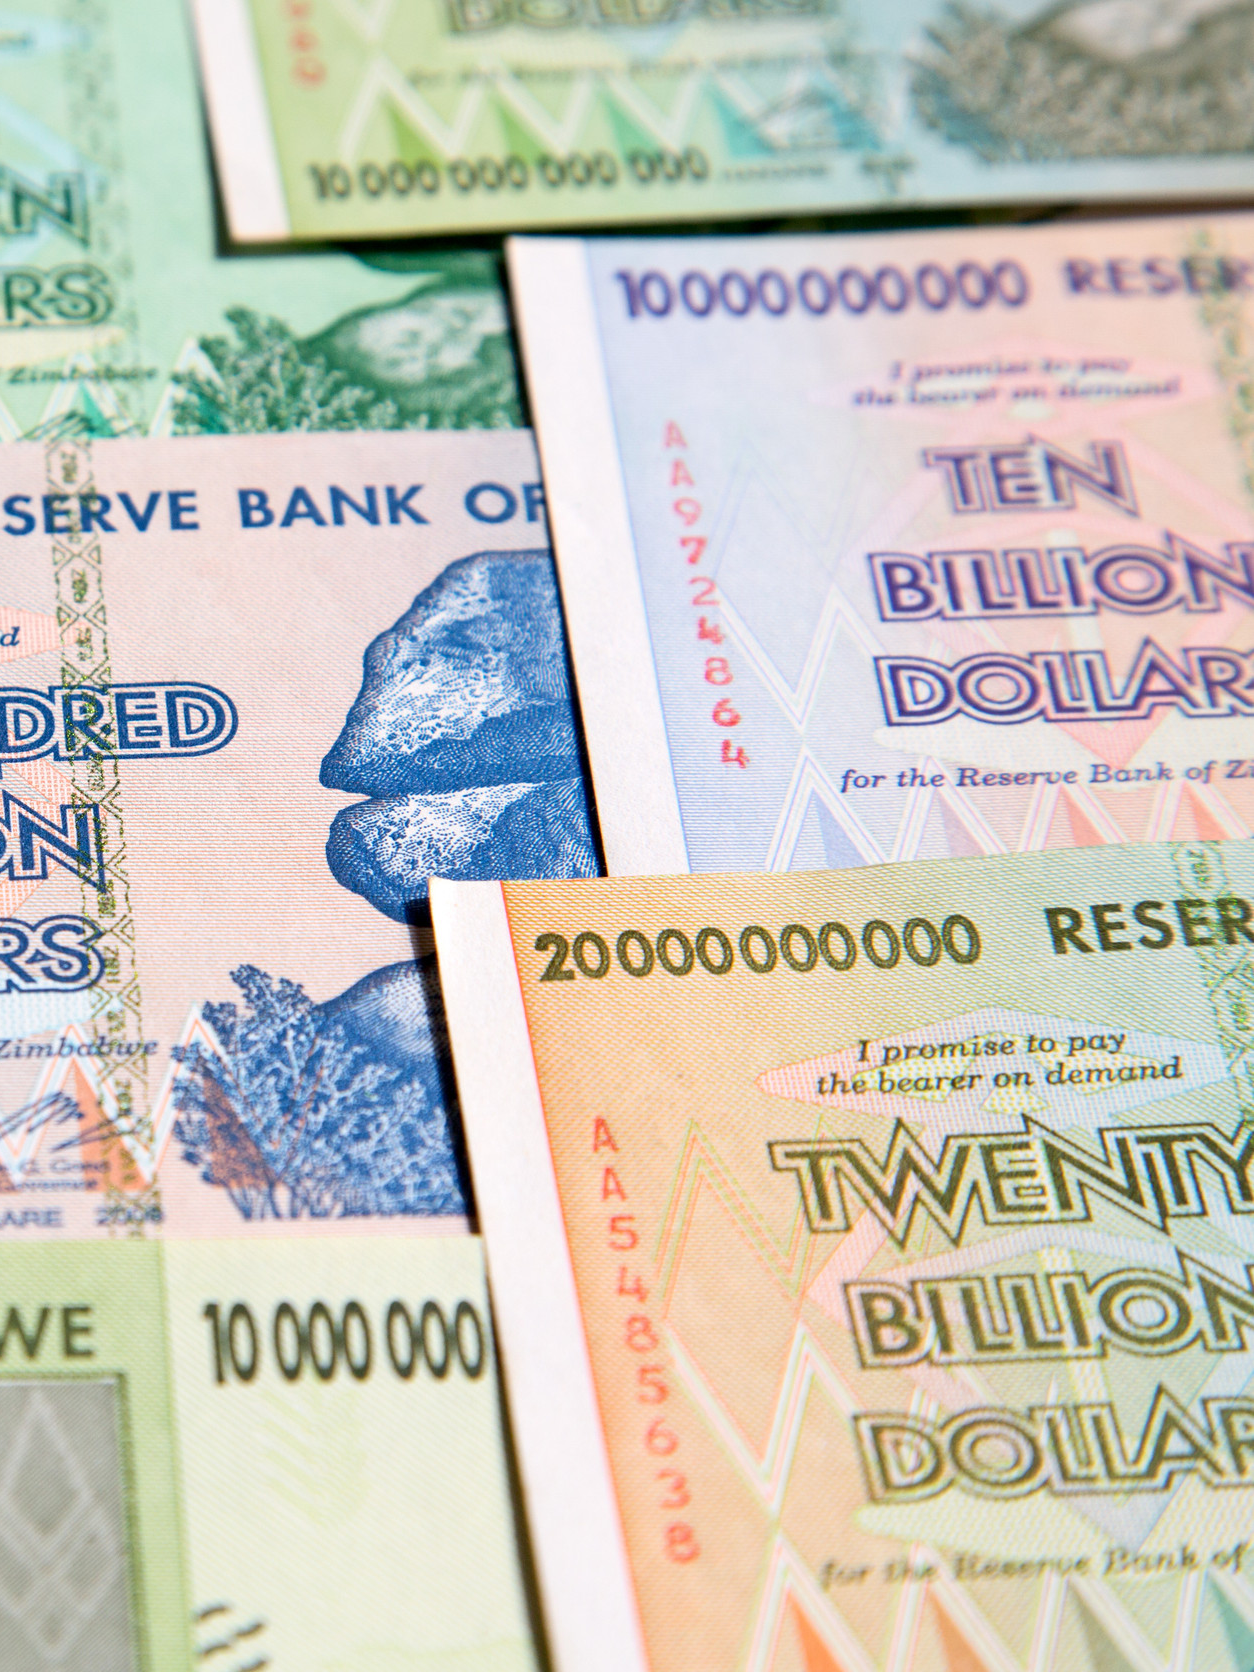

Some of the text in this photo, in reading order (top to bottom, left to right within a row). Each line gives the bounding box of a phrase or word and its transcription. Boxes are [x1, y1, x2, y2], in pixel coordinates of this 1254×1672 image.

[921, 433, 1140, 518] TEN
[236, 483, 430, 531] BANK
[463, 480, 547, 525] OF
[873, 636, 1254, 728] DOLLAR
[841, 768, 887, 794] for
[896, 767, 946, 790] the
[956, 764, 1079, 787] Reserve
[1088, 761, 1175, 785] Bank
[1184, 760, 1219, 785] of
[856, 1029, 1127, 1066] I promise to pay
[817, 1056, 1184, 1095] the bearer on demand
[202, 1298, 485, 1386] 10 000 000
[820, 1543, 1248, 1592] for the Reserve Bank of
